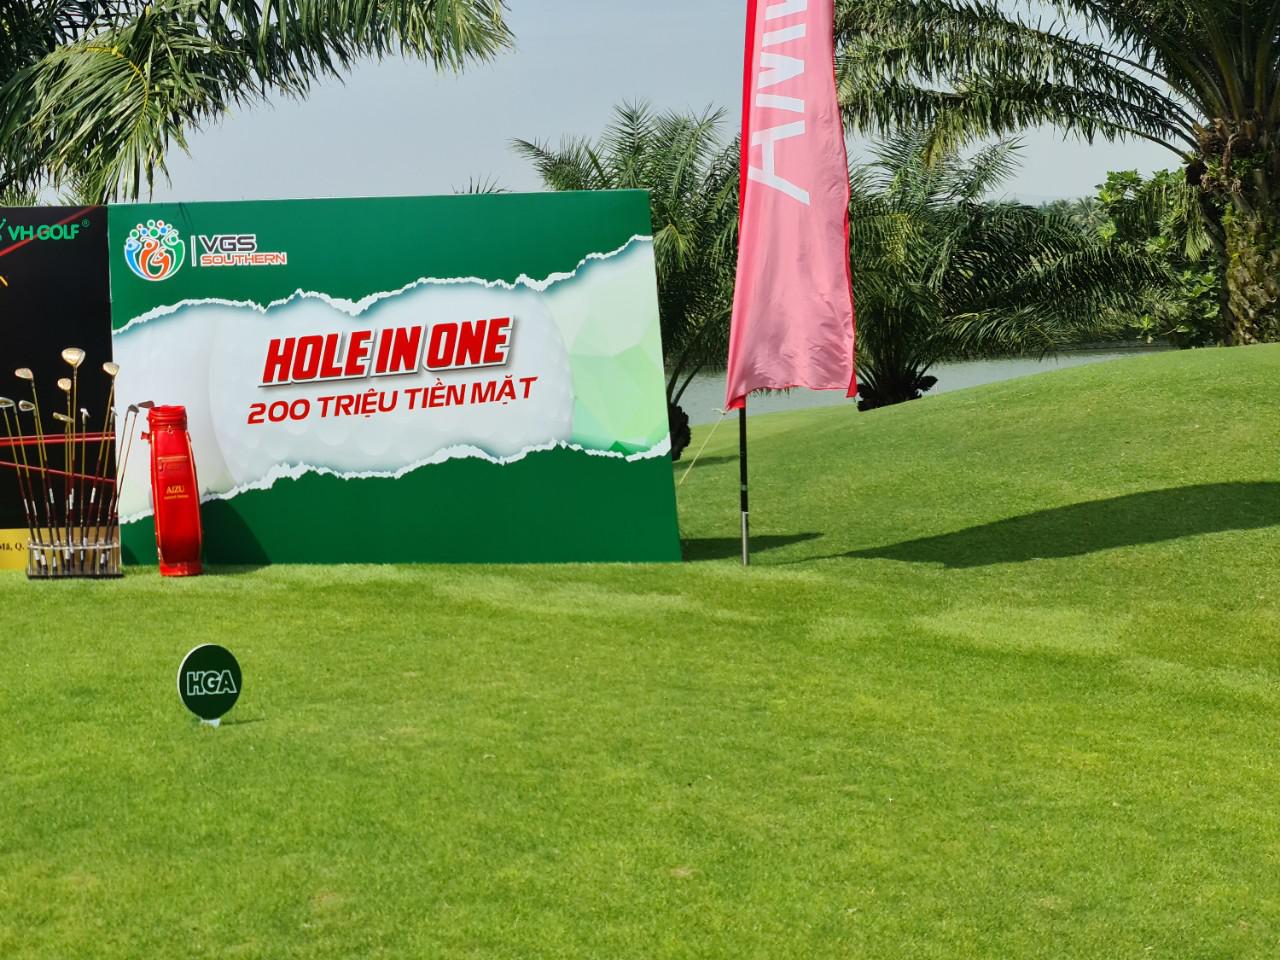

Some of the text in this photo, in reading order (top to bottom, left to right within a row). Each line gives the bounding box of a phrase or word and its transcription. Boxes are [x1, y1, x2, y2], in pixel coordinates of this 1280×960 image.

[7, 224, 80, 241] VH GOLF
[199, 234, 257, 253] VGS
[200, 252, 288, 267] SOUTHERN
[261, 317, 511, 385] HOLE IN ONE
[247, 375, 539, 425] 200 TRIỆU TIỀN MẶT
[186, 669, 238, 696] HGA
